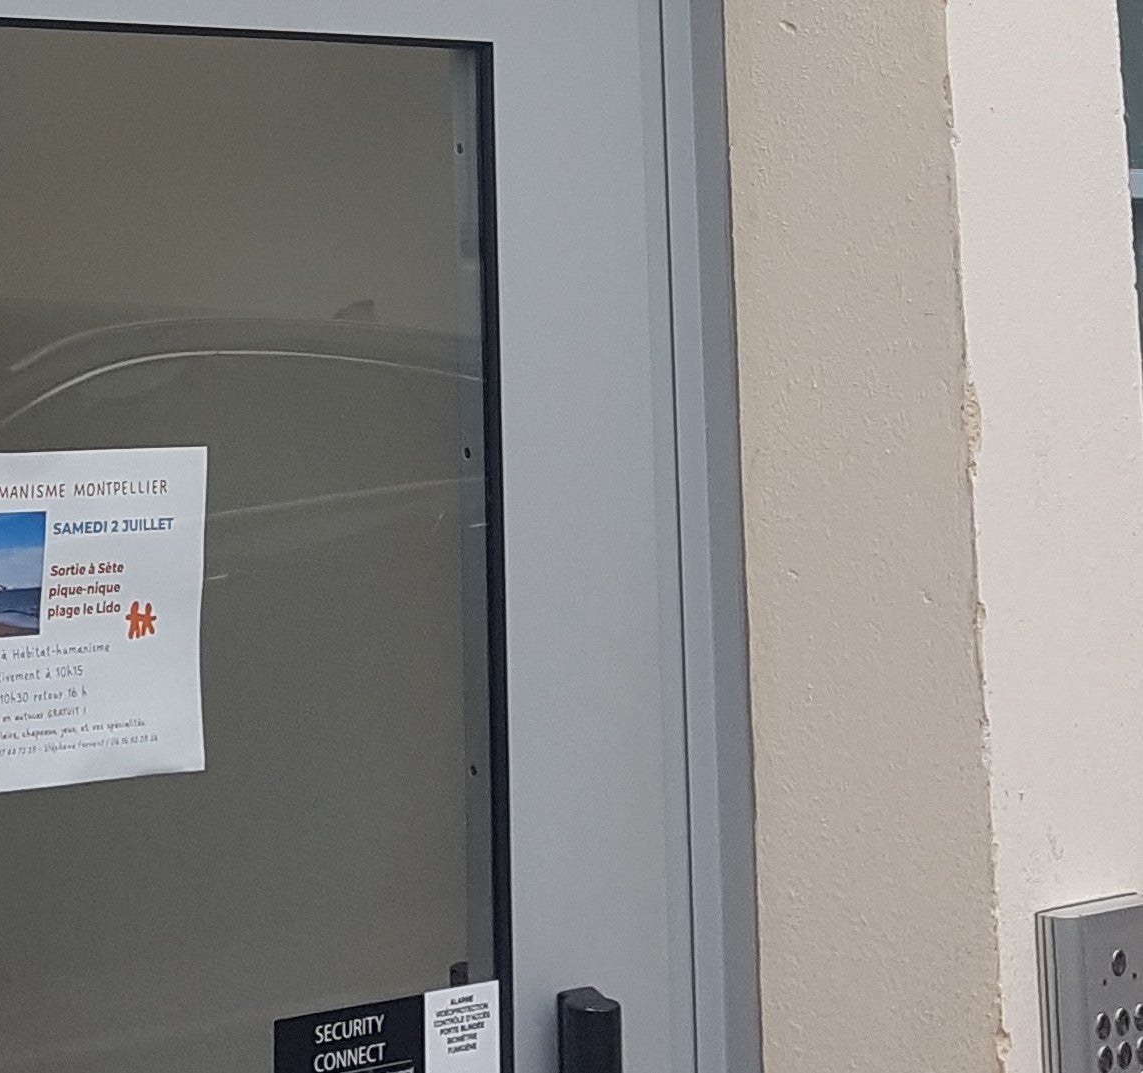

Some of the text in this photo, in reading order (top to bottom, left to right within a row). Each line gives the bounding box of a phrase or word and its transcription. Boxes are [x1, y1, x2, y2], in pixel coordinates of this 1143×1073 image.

[73, 479, 169, 499] MONTPELLIER
[53, 517, 175, 536] SAMEDI 2 JUILLET
[50, 562, 125, 577] Sortie à Sète
[48, 581, 121, 600] pique-nique
[47, 600, 121, 620] plage le Lido
[1, 649, 8, 661] à
[12, 643, 111, 660] Habitat-humanisme
[45, 667, 52, 679] à
[56, 664, 84, 678] 10h15
[0, 691, 29, 705] 10h30
[33, 690, 63, 702] retour
[67, 686, 78, 699] 16
[314, 1013, 385, 1044] SECURITY
[313, 1042, 387, 1073] CONNECT
